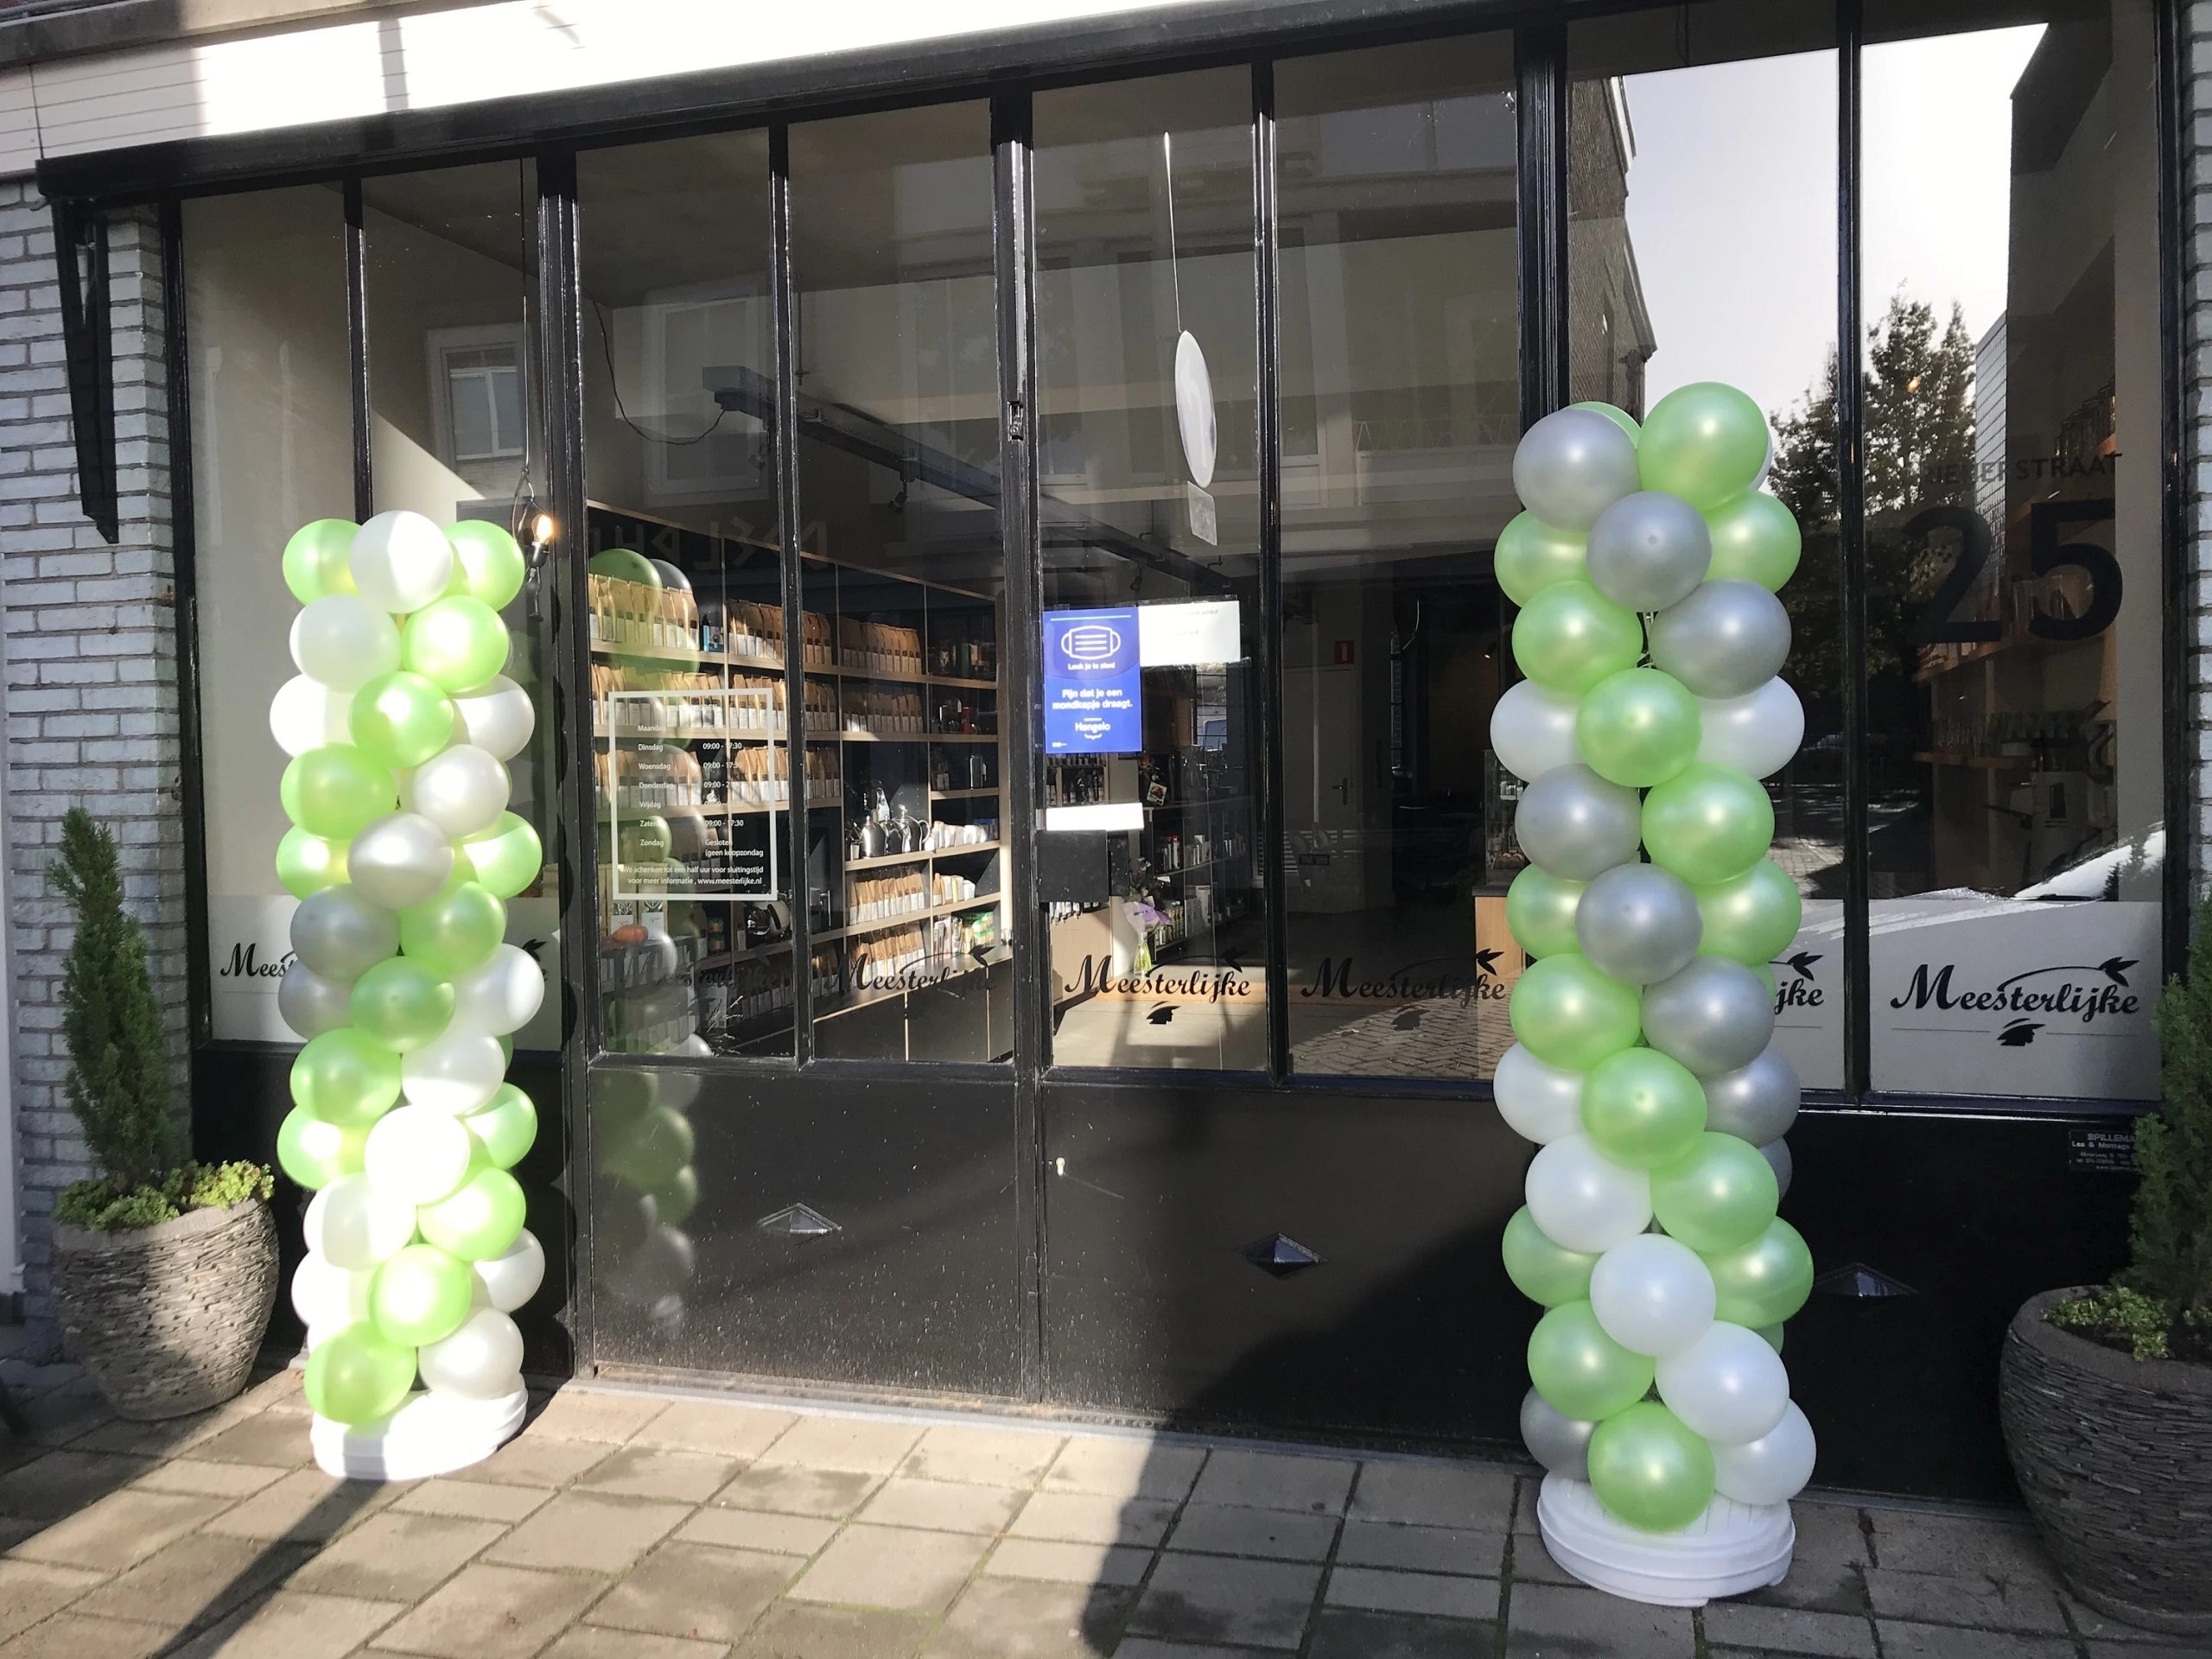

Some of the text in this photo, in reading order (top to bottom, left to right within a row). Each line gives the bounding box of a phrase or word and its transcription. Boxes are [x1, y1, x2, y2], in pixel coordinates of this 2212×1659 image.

[1903, 499, 2123, 643] 25
[1061, 689, 1078, 699] Fijn
[1079, 689, 1094, 697] dat
[1096, 689, 1104, 698] je
[1052, 699, 1100, 710] mondkapje
[637, 724, 666, 733] Maandag
[1074, 721, 1111, 734] Hengelo
[638, 743, 664, 752] Dinsdag
[638, 762, 671, 771] Woensdag
[639, 781, 674, 790] Donderdag
[639, 801, 661, 810] Vrijdag
[640, 838, 733, 848] Zondag Gesloten
[705, 849, 723, 857] (geen
[687, 865, 699, 874] half
[1065, 954, 1251, 1003] Meesterlijke
[1301, 957, 1507, 1008] Meesterlijke
[1891, 963, 2140, 1023] Meesterlijke
[2087, 1133, 2136, 1142] SPILLEMA
